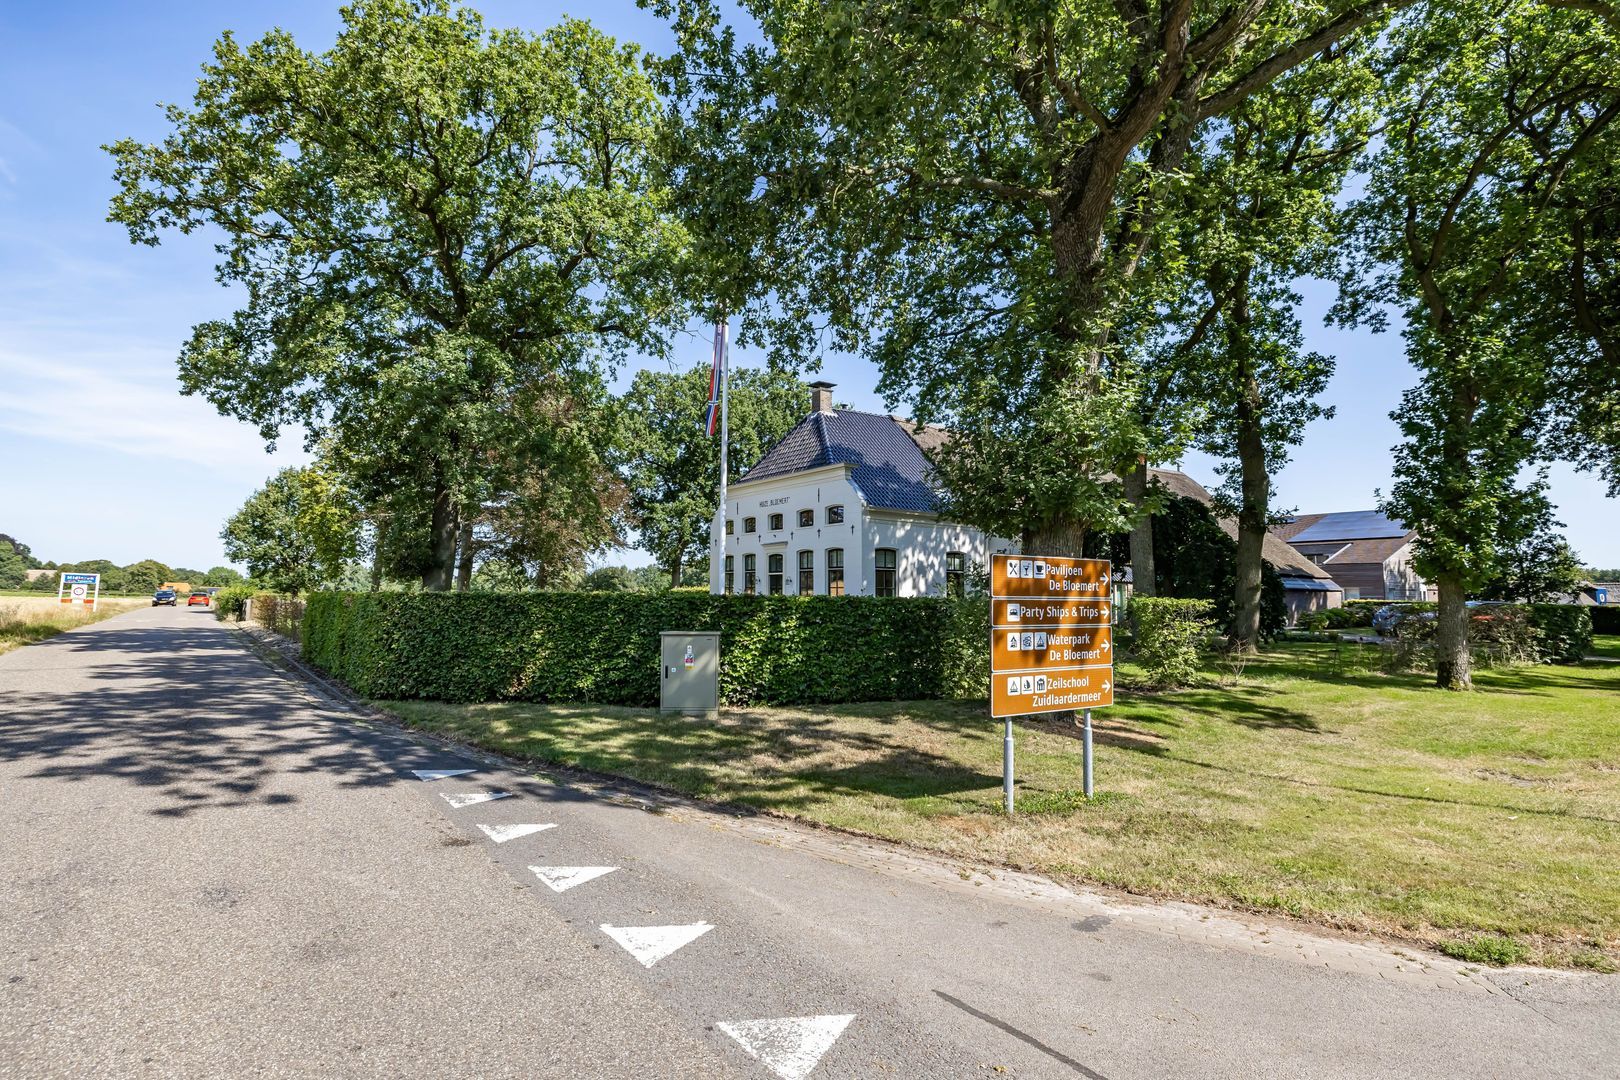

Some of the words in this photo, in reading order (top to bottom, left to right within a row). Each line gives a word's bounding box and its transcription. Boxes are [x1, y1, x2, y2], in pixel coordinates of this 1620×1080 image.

[1046, 564, 1083, 578] Paviljoen
[1049, 579, 1061, 591] De
[1062, 579, 1100, 592] Bloemert
[1020, 606, 1045, 621] Party
[1046, 605, 1070, 620] Ships
[1071, 606, 1078, 617] &
[1079, 606, 1099, 619] Trips
[1047, 632, 1091, 647] Waterpark
[1049, 649, 1061, 661] De
[1063, 648, 1101, 661] Bloemert
[1047, 675, 1089, 690] Zeilschool
[1032, 691, 1102, 707] Zuidlaardermeer
